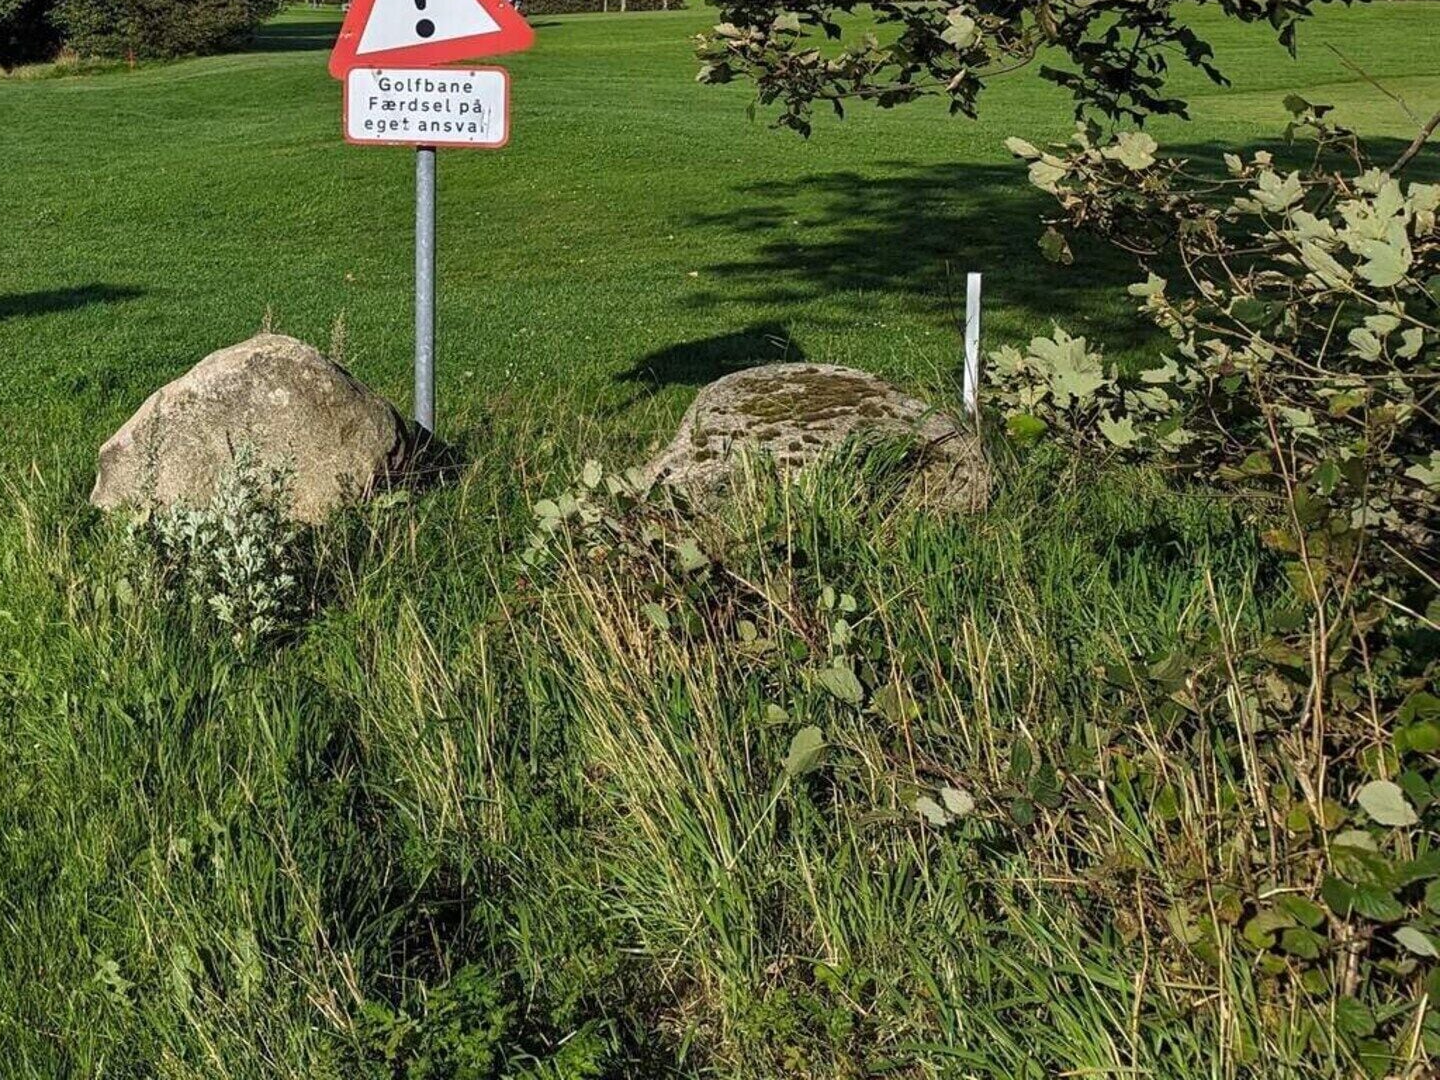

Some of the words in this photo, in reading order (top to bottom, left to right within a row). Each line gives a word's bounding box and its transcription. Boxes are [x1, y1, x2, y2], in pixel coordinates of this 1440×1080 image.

[378, 77, 473, 93] Golfbane
[368, 96, 451, 112] Færdsel
[459, 99, 482, 115] på
[364, 117, 409, 133] eget
